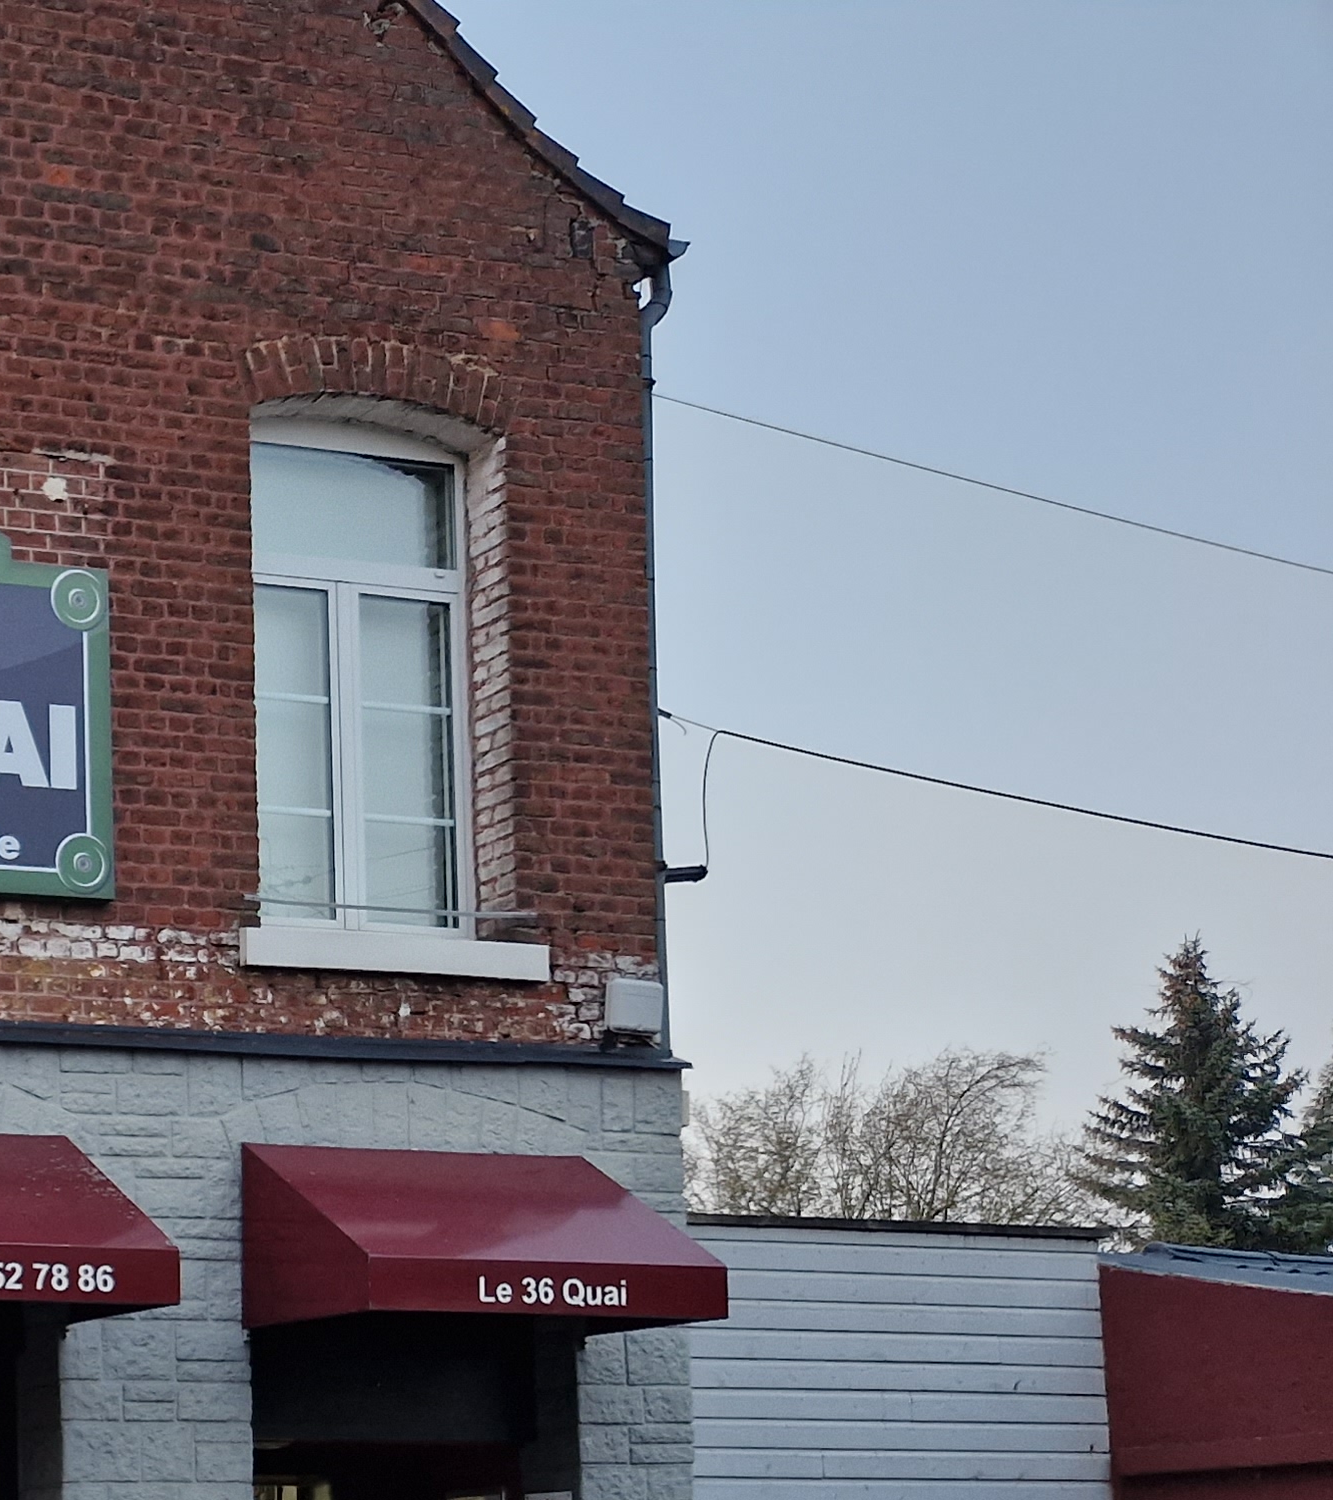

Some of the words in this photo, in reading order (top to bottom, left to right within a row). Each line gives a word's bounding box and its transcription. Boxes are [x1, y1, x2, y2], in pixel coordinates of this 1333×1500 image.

[32, 1263, 69, 1291] 78
[77, 1264, 115, 1292] 86
[478, 1276, 513, 1303] Le
[521, 1277, 555, 1305] 36
[562, 1278, 627, 1307] Quai
